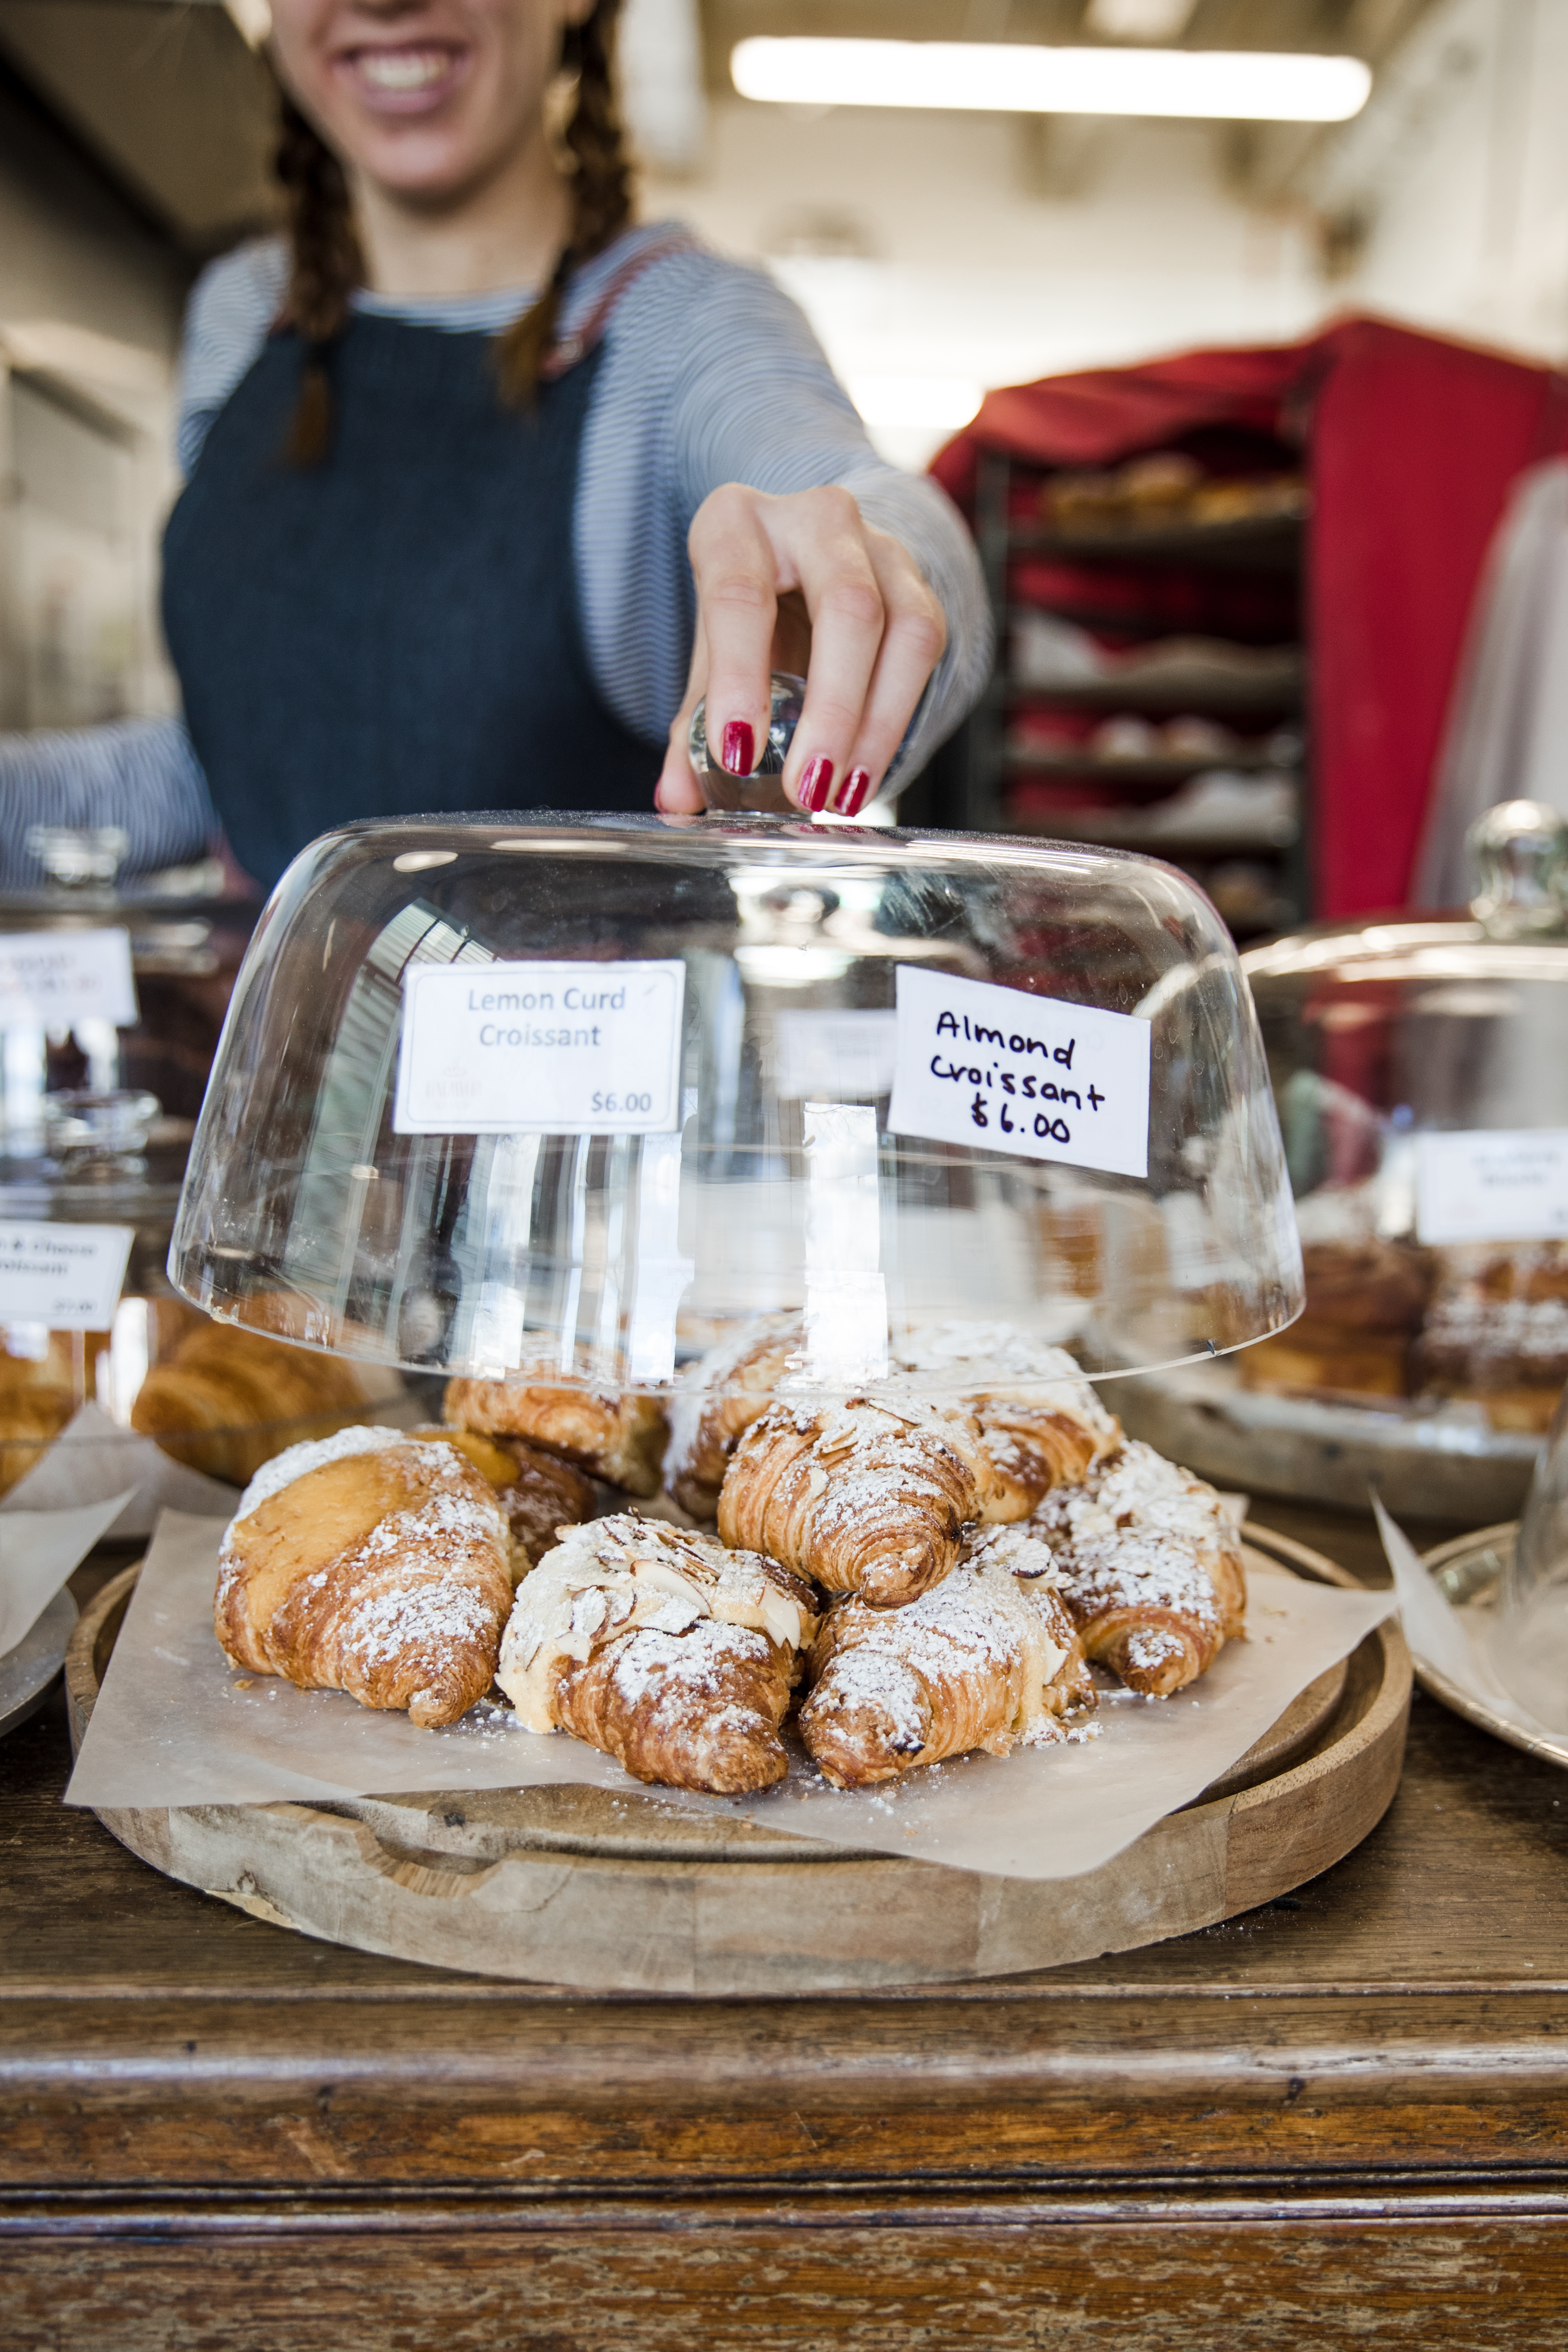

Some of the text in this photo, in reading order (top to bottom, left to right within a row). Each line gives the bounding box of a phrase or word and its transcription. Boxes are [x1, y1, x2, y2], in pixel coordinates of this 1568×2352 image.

[468, 987, 625, 1011] Lemon Curd
[479, 1024, 601, 1047] Croissant
[936, 1011, 1075, 1071] Almond
[592, 1091, 652, 1113] $6.00
[971, 1092, 1070, 1144] $6.00
